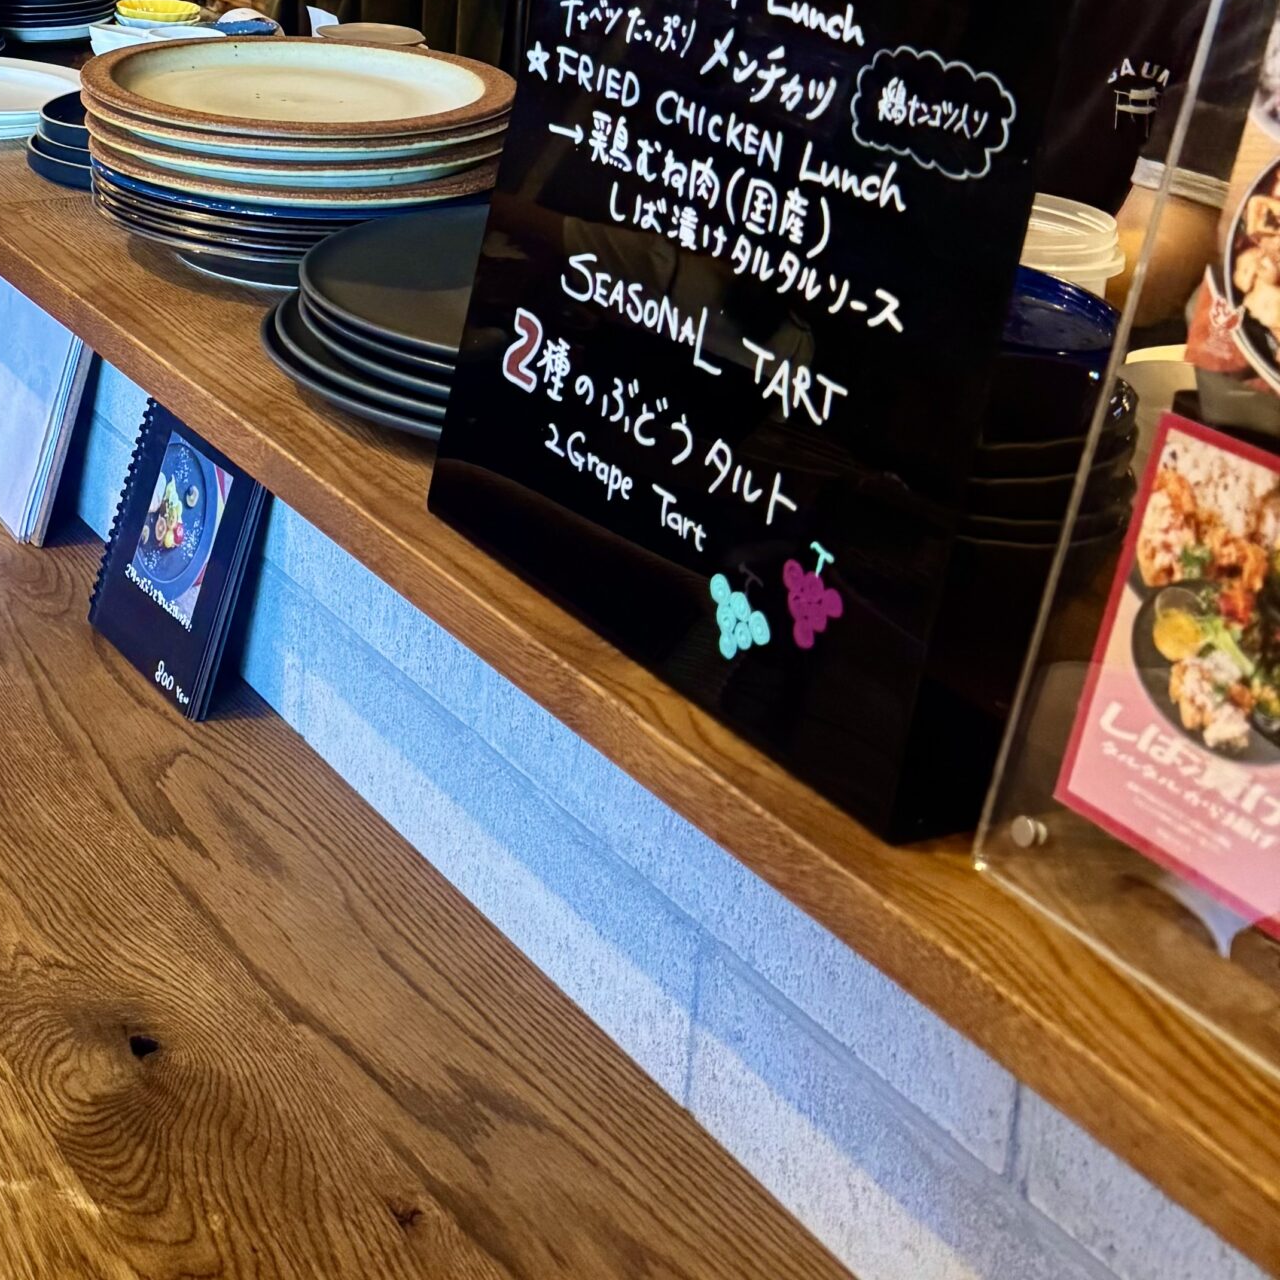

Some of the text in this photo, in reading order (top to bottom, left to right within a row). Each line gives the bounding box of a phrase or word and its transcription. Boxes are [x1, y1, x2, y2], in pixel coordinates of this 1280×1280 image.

[556, 44, 907, 213] FRIED CHICKEN Lunch
[560, 253, 849, 426] SEASONAL TART
[651, 483, 708, 552] Tart
[155, 660, 174, 690] 800
